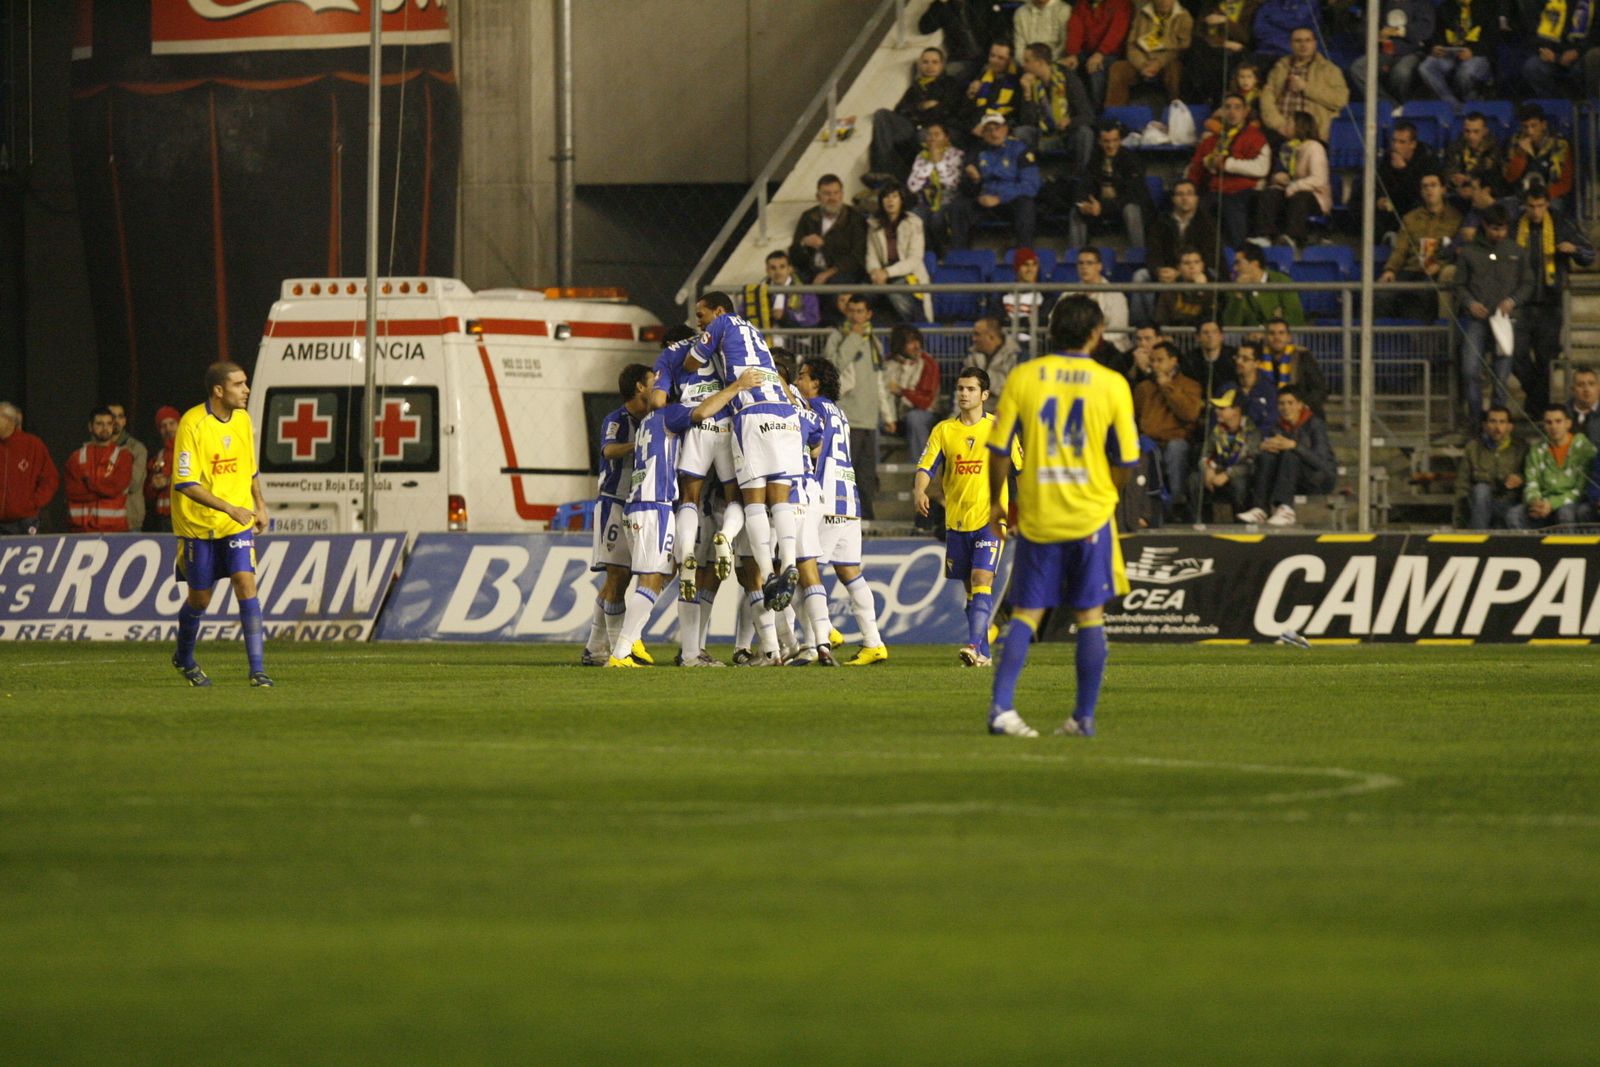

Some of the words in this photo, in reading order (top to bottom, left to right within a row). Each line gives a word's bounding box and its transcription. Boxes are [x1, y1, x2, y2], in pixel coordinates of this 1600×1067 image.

[281, 341, 426, 361] AMBULNCIA
[1038, 396, 1085, 458] 14
[300, 478, 323, 491] Cruz
[325, 478, 347, 493] Roja
[349, 478, 392, 493] Espola
[607, 524, 619, 542] 6
[989, 547, 998, 566] 7
[1122, 588, 1186, 611] CEA
[1184, 612, 1200, 623] de
[15, 624, 92, 641] REAL
[1143, 624, 1160, 634] de
